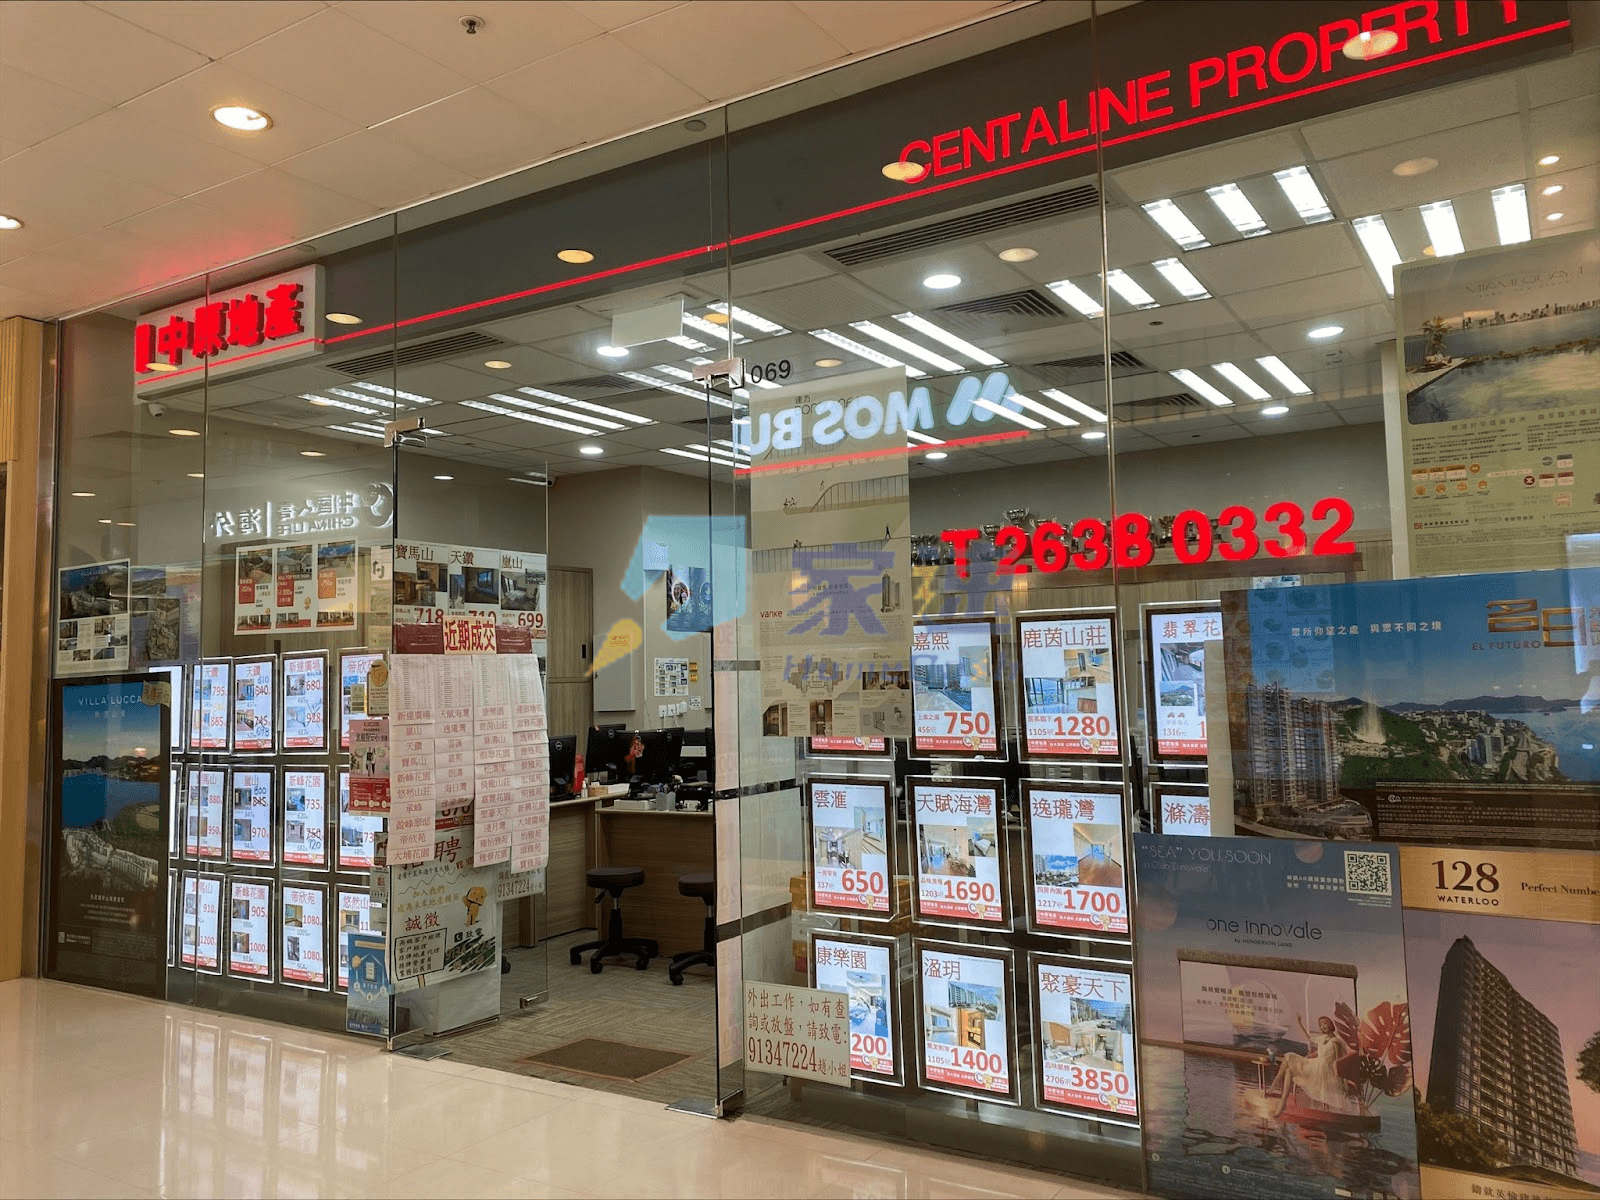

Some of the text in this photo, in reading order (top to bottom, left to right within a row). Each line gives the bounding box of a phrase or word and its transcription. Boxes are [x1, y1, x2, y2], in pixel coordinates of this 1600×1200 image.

[898, 70, 1175, 184] CENTALINE
[156, 283, 304, 365] 中原地產
[751, 359, 791, 384] 069
[939, 497, 1357, 579] T 2638 0332
[395, 545, 434, 562] 寶馬山
[501, 555, 523, 569] 嵐山
[517, 612, 544, 628] 699
[760, 610, 783, 618] vanke
[444, 620, 496, 651] 近期成交
[1023, 625, 1107, 648] 鹿茵山莊
[1163, 619, 1221, 639] 翡翠花
[913, 631, 949, 652] 嘉熙
[1472, 640, 1541, 651] EL FUTURO
[78, 695, 142, 706] VILLA LUCCA
[944, 712, 990, 735] 750
[1054, 715, 1110, 737] 1280
[917, 793, 992, 816] 天賦海灣
[1033, 797, 1095, 822] 逸瓏灣
[363, 832, 374, 843] 73
[1187, 848, 1221, 863] YOU
[1226, 850, 1272, 865] SOON
[841, 869, 884, 894] 650
[1432, 859, 1500, 894] 128
[1521, 881, 1558, 894] Perfect
[944, 880, 995, 902] 1690
[1063, 889, 1120, 914] 1700
[1437, 894, 1500, 906] WATERLOO
[405, 911, 441, 931] 誠徵
[1206, 918, 1240, 933] one
[1242, 939, 1276, 947] HENDERSON
[816, 946, 866, 971] 康樂園
[1040, 972, 1126, 1001] 聚豪天下
[851, 1033, 887, 1056] 200
[950, 1047, 1002, 1074] 1400
[1071, 1067, 1129, 1095] 3850
